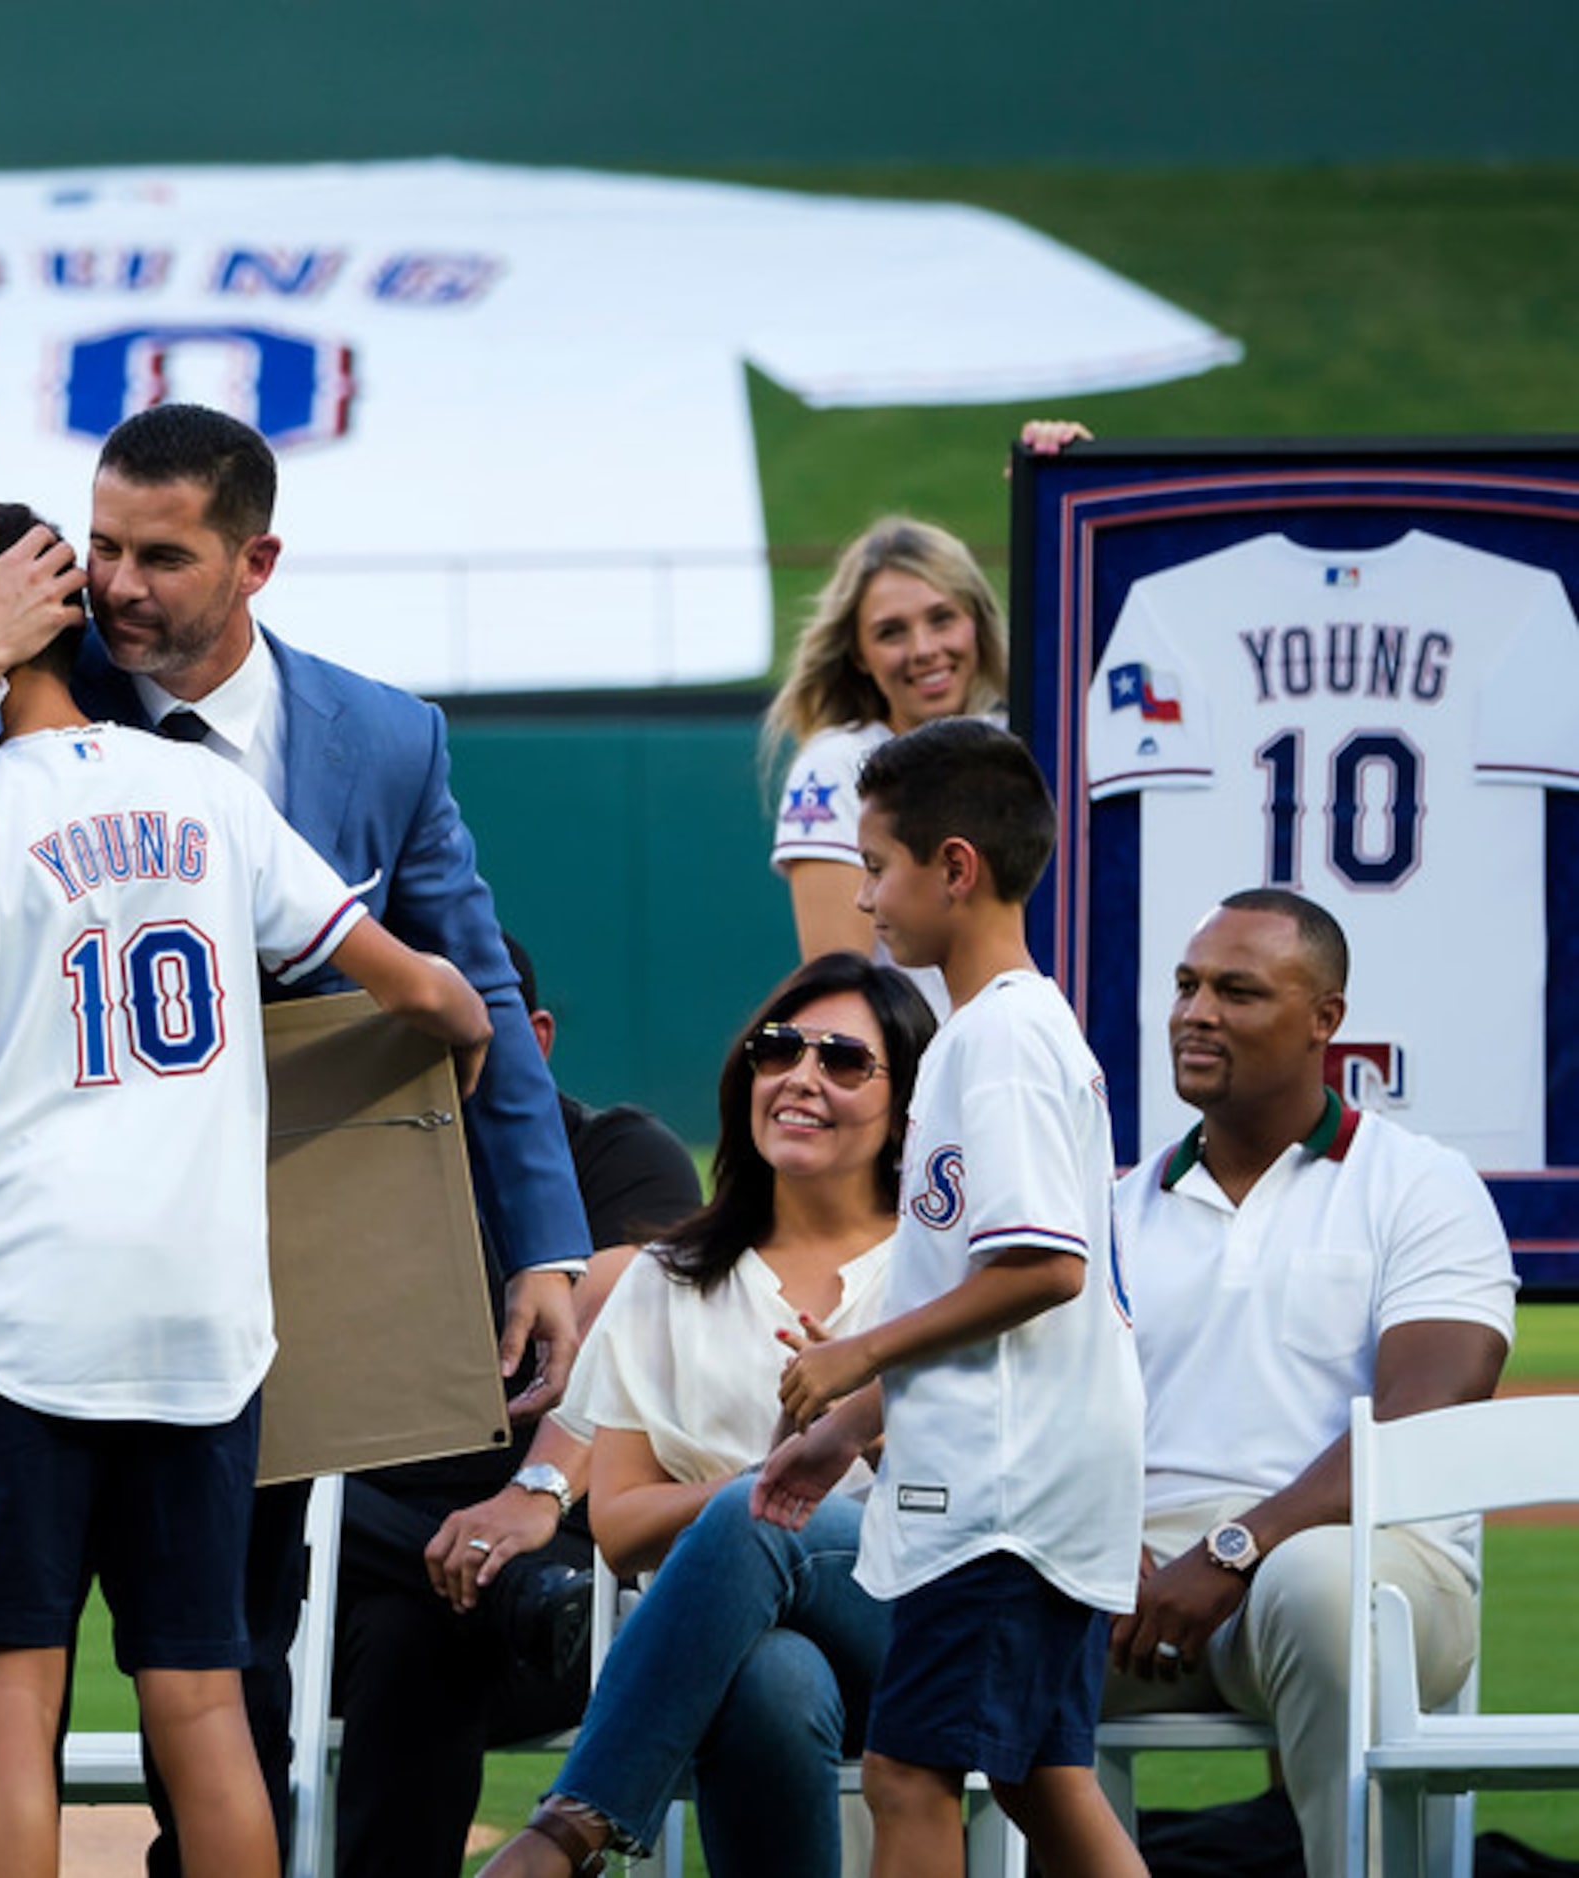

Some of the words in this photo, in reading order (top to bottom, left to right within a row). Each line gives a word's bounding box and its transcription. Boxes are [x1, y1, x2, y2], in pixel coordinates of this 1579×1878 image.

[1238, 623, 1454, 704] YOUNG
[30, 811, 209, 902] YOUNG
[1253, 727, 1428, 893] 10
[63, 919, 225, 1087] 10
